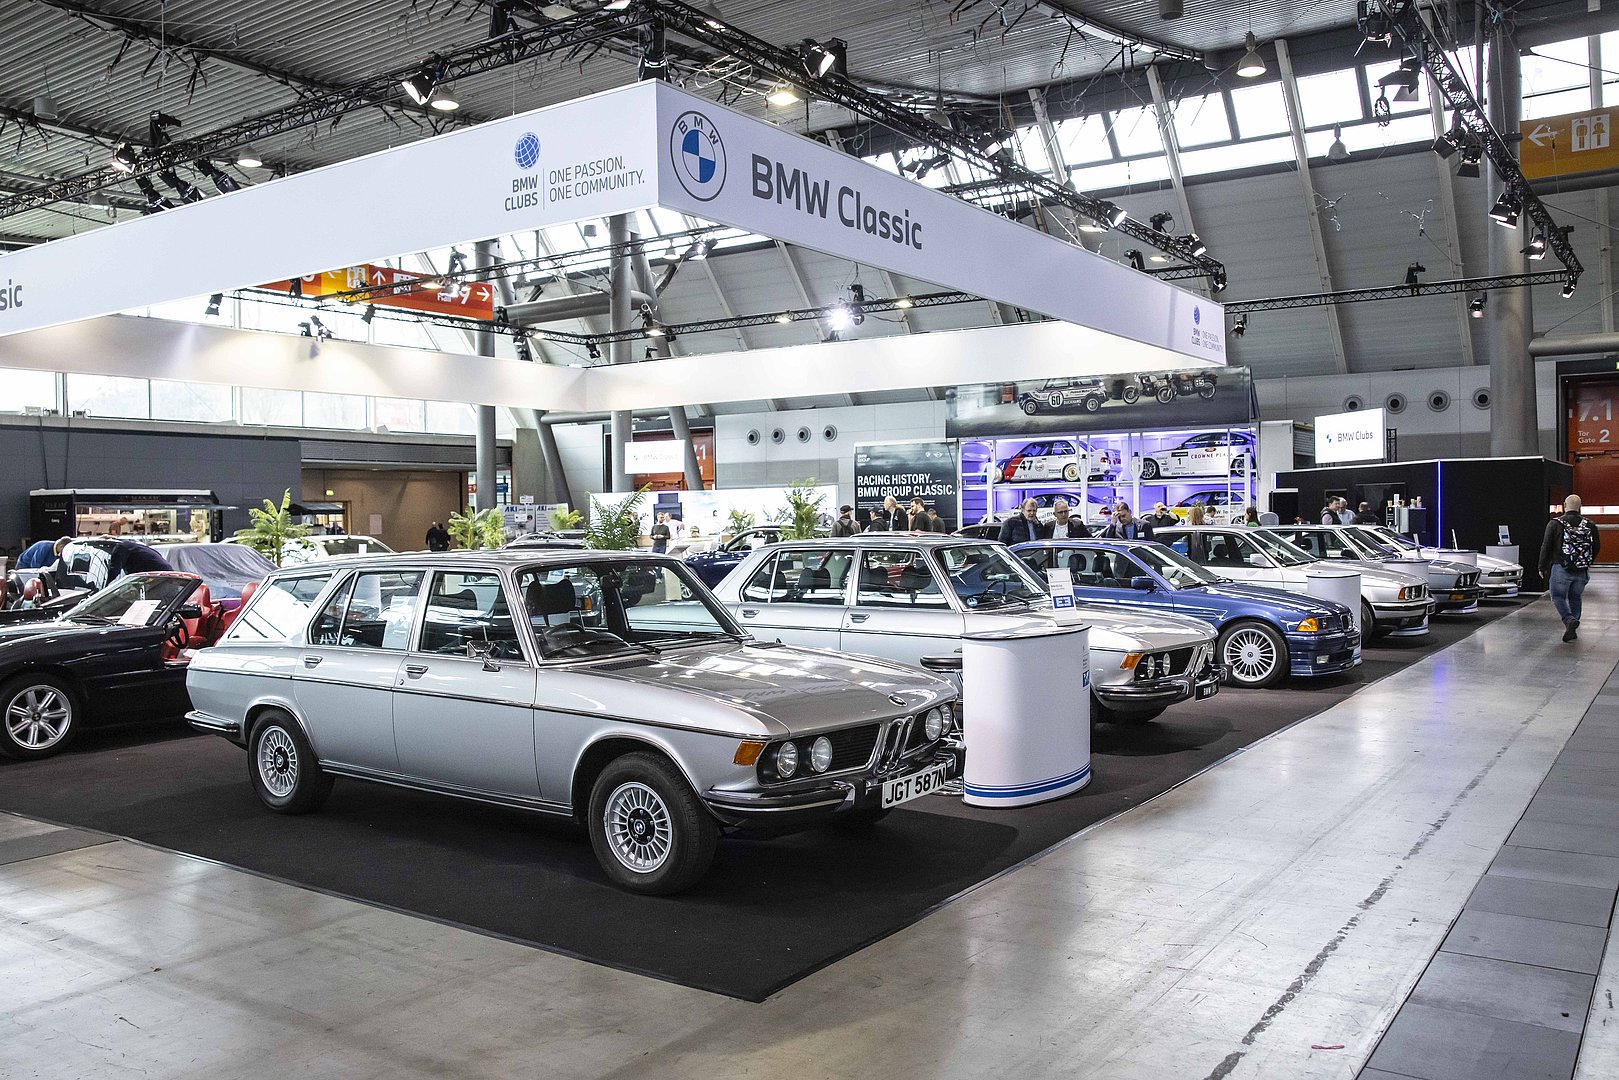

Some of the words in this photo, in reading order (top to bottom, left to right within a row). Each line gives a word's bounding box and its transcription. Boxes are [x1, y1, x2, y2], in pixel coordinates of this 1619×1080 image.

[677, 116, 719, 145] BMW
[549, 166, 572, 185] ONE
[574, 155, 626, 180] PASSION.
[512, 174, 539, 194] BMW
[549, 184, 572, 203] ONE
[574, 169, 645, 197] COMMUNITY.
[504, 192, 539, 212] CLUBS
[752, 153, 830, 219] BMW
[838, 185, 923, 250] Classic
[1051, 394, 1061, 406] 60
[1576, 398, 1612, 423] 7.1
[1337, 432, 1355, 443] BMW
[1355, 430, 1374, 441] Clubs
[1599, 428, 1611, 443] 2
[1019, 460, 1034, 471] 47
[857, 474, 890, 486] RACING
[891, 473, 933, 485] HISTORY.
[857, 487, 879, 498] BMW
[880, 485, 912, 497] GROUP
[913, 483, 956, 496] CLASSIC.
[885, 778, 912, 804] JGT
[914, 767, 946, 795] 587N
